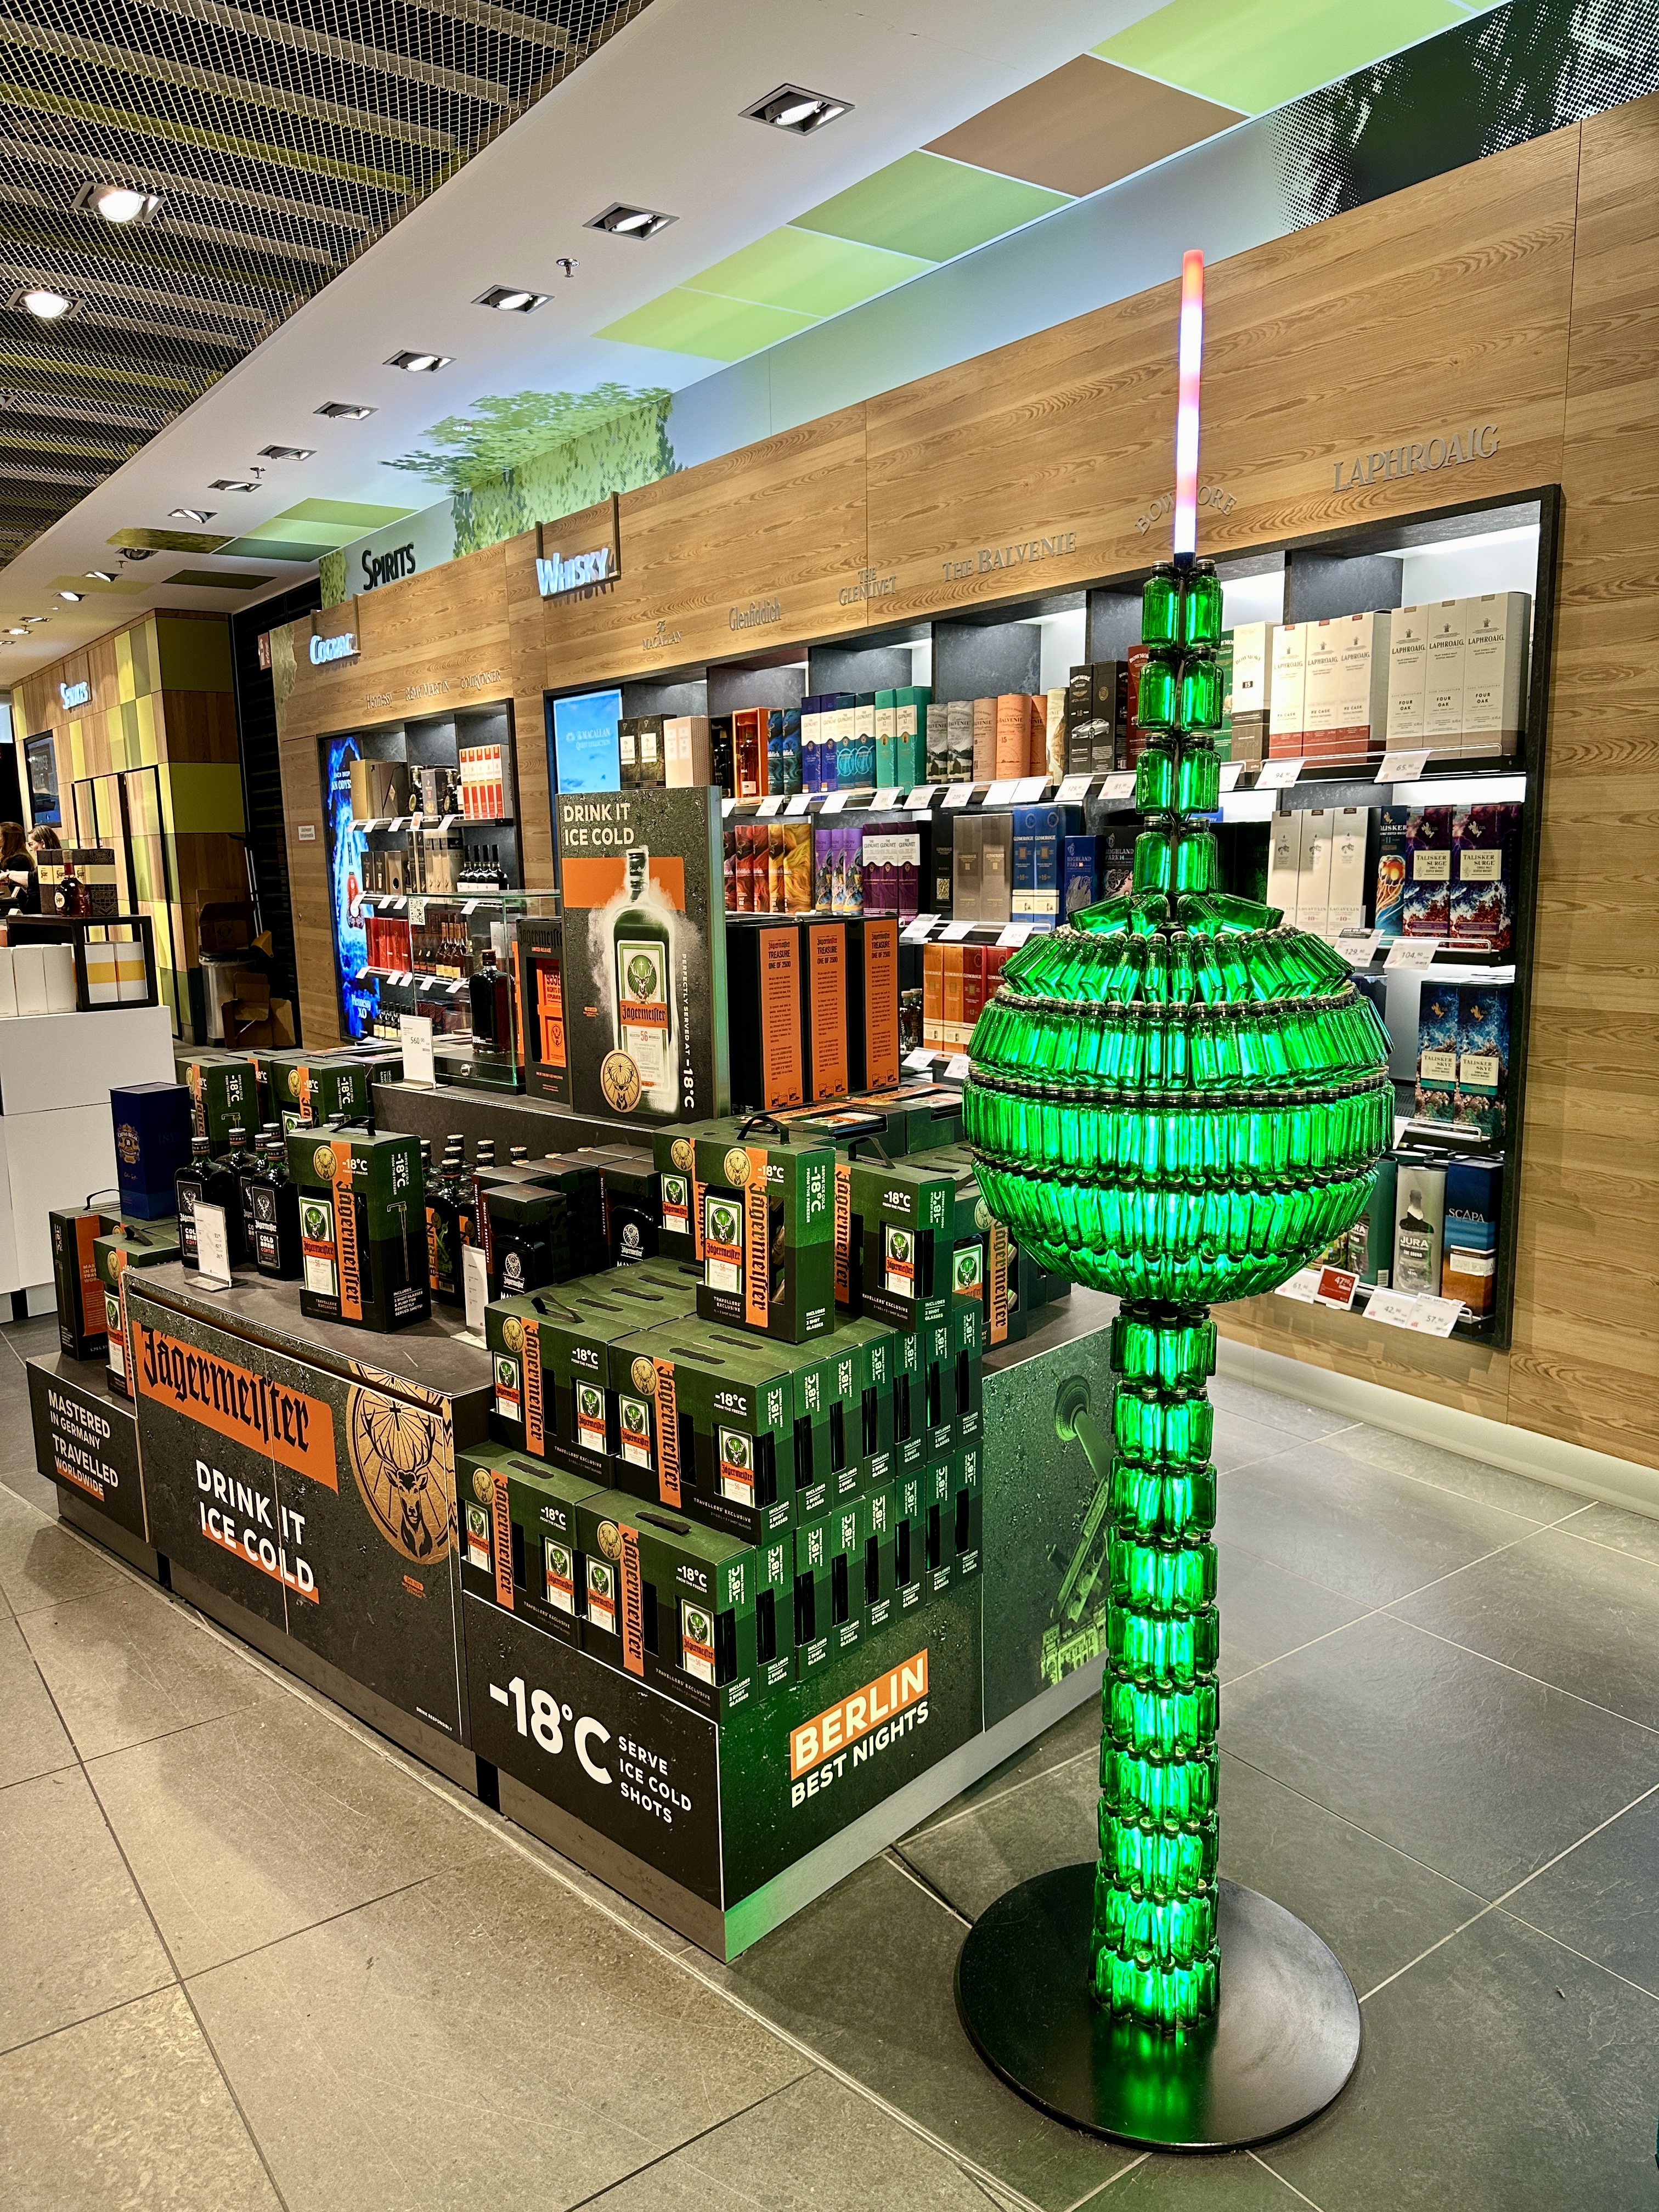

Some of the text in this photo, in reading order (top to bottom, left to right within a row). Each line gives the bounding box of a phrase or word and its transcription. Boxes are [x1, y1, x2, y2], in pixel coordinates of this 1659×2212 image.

[1333, 424, 1500, 493] LAPHROAIG
[1135, 484, 1238, 536] BOWORE
[942, 531, 1077, 582] THE BALVENIE
[362, 543, 416, 591] SPIRITS
[536, 548, 609, 597] WHISKY
[857, 566, 877, 584] THE
[838, 575, 898, 605] GLENLIVET
[729, 596, 782, 631] Glenfiddich
[642, 630, 683, 651] MACALLAN
[1429, 639, 1465, 650] LAPHROAIG
[1468, 634, 1505, 645] LAPHROAIG
[1341, 651, 1370, 662] LAPHROAIG
[1392, 644, 1426, 655] LAPHROAIG
[1308, 656, 1339, 666] LAPHROAIG
[583, 727, 611, 738] MACALLAN
[338, 778, 352, 790] ODYS
[563, 802, 630, 822] DRINK IT
[565, 827, 634, 846] ICE COLD
[817, 946, 838, 955] TREASURE
[871, 940, 890, 949] TREASURE
[769, 950, 791, 959] TREASURE
[358, 1007, 367, 1019] XO
[640, 1030, 648, 1042] 56
[684, 1043, 691, 1055] AT
[1424, 1054, 1453, 1063] TALISKER
[342, 1158, 368, 1172] -18°C
[757, 1164, 785, 1179] -18°C
[810, 1166, 821, 1214] -18°C
[883, 1190, 911, 1207] -18°C
[1448, 1207, 1485, 1223] SCAPA
[260, 1235, 274, 1244] COLD
[1400, 1235, 1429, 1248] JURA
[572, 1347, 599, 1365] -18°C
[715, 1392, 747, 1411] -18°C
[48, 1389, 111, 1440] MASTERED
[50, 1410, 101, 1451] IN GERMANY
[52, 1432, 119, 1488] TRAVELLED
[54, 1454, 105, 1497] WORLDWIDE
[195, 1459, 306, 1545] DRINK IT
[540, 1505, 567, 1526] -18°C
[199, 1500, 315, 1593] ICE COLD
[676, 1565, 708, 1588] -18°C
[795, 1656, 924, 1771] BERLIN
[489, 1675, 613, 1785] -18°C
[618, 1736, 668, 1776] SERVE
[792, 1701, 929, 1809] BEST NIGHTS
[619, 1757, 692, 1812] ICE COLD
[620, 1782, 673, 1824] SHOTS
